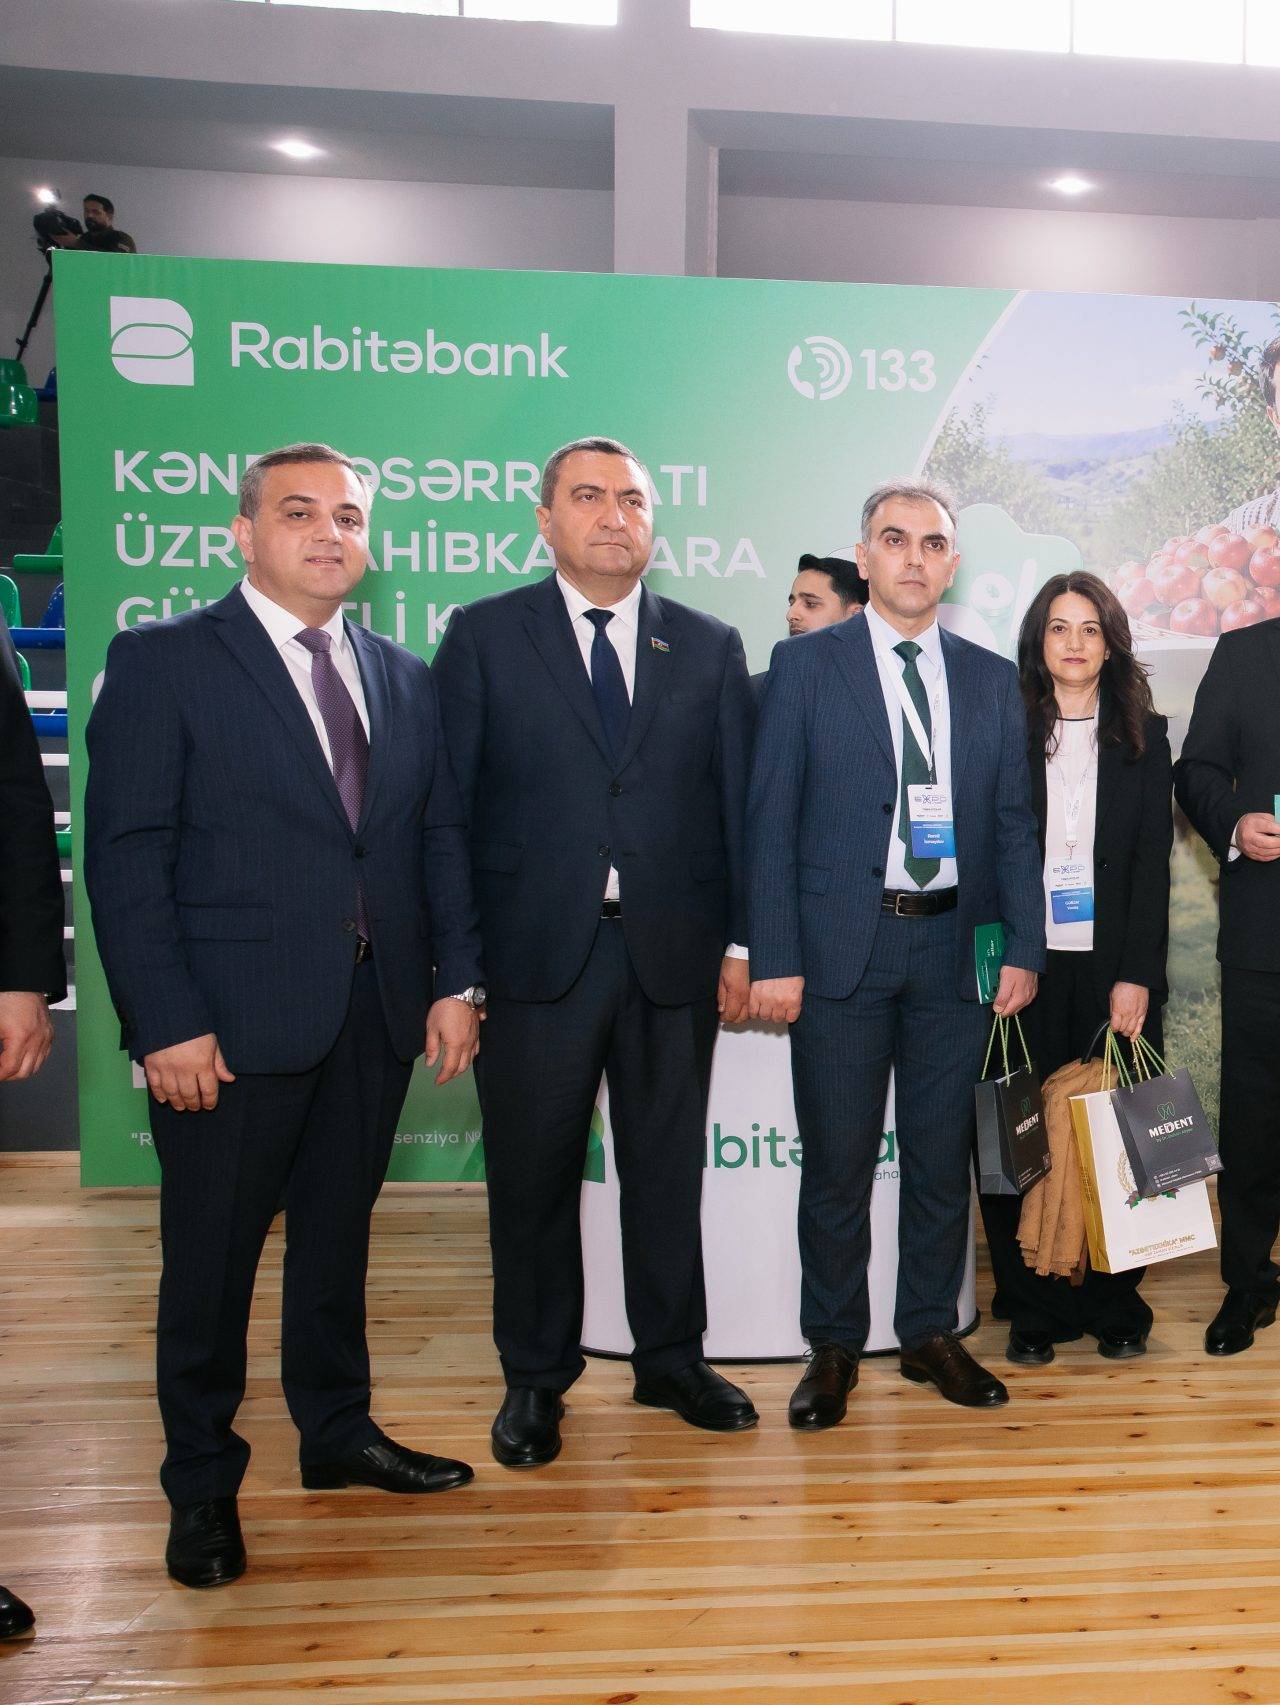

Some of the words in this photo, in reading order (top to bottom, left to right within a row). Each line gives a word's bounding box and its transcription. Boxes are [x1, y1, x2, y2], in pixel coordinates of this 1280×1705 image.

[231, 321, 570, 378] Rabitəbank
[859, 348, 937, 393] 133
[114, 449, 262, 496] KƏN
[116, 512, 239, 569] ÜZR
[394, 1130, 459, 1147] senziya
[1148, 1116, 1194, 1138] MEDENT
